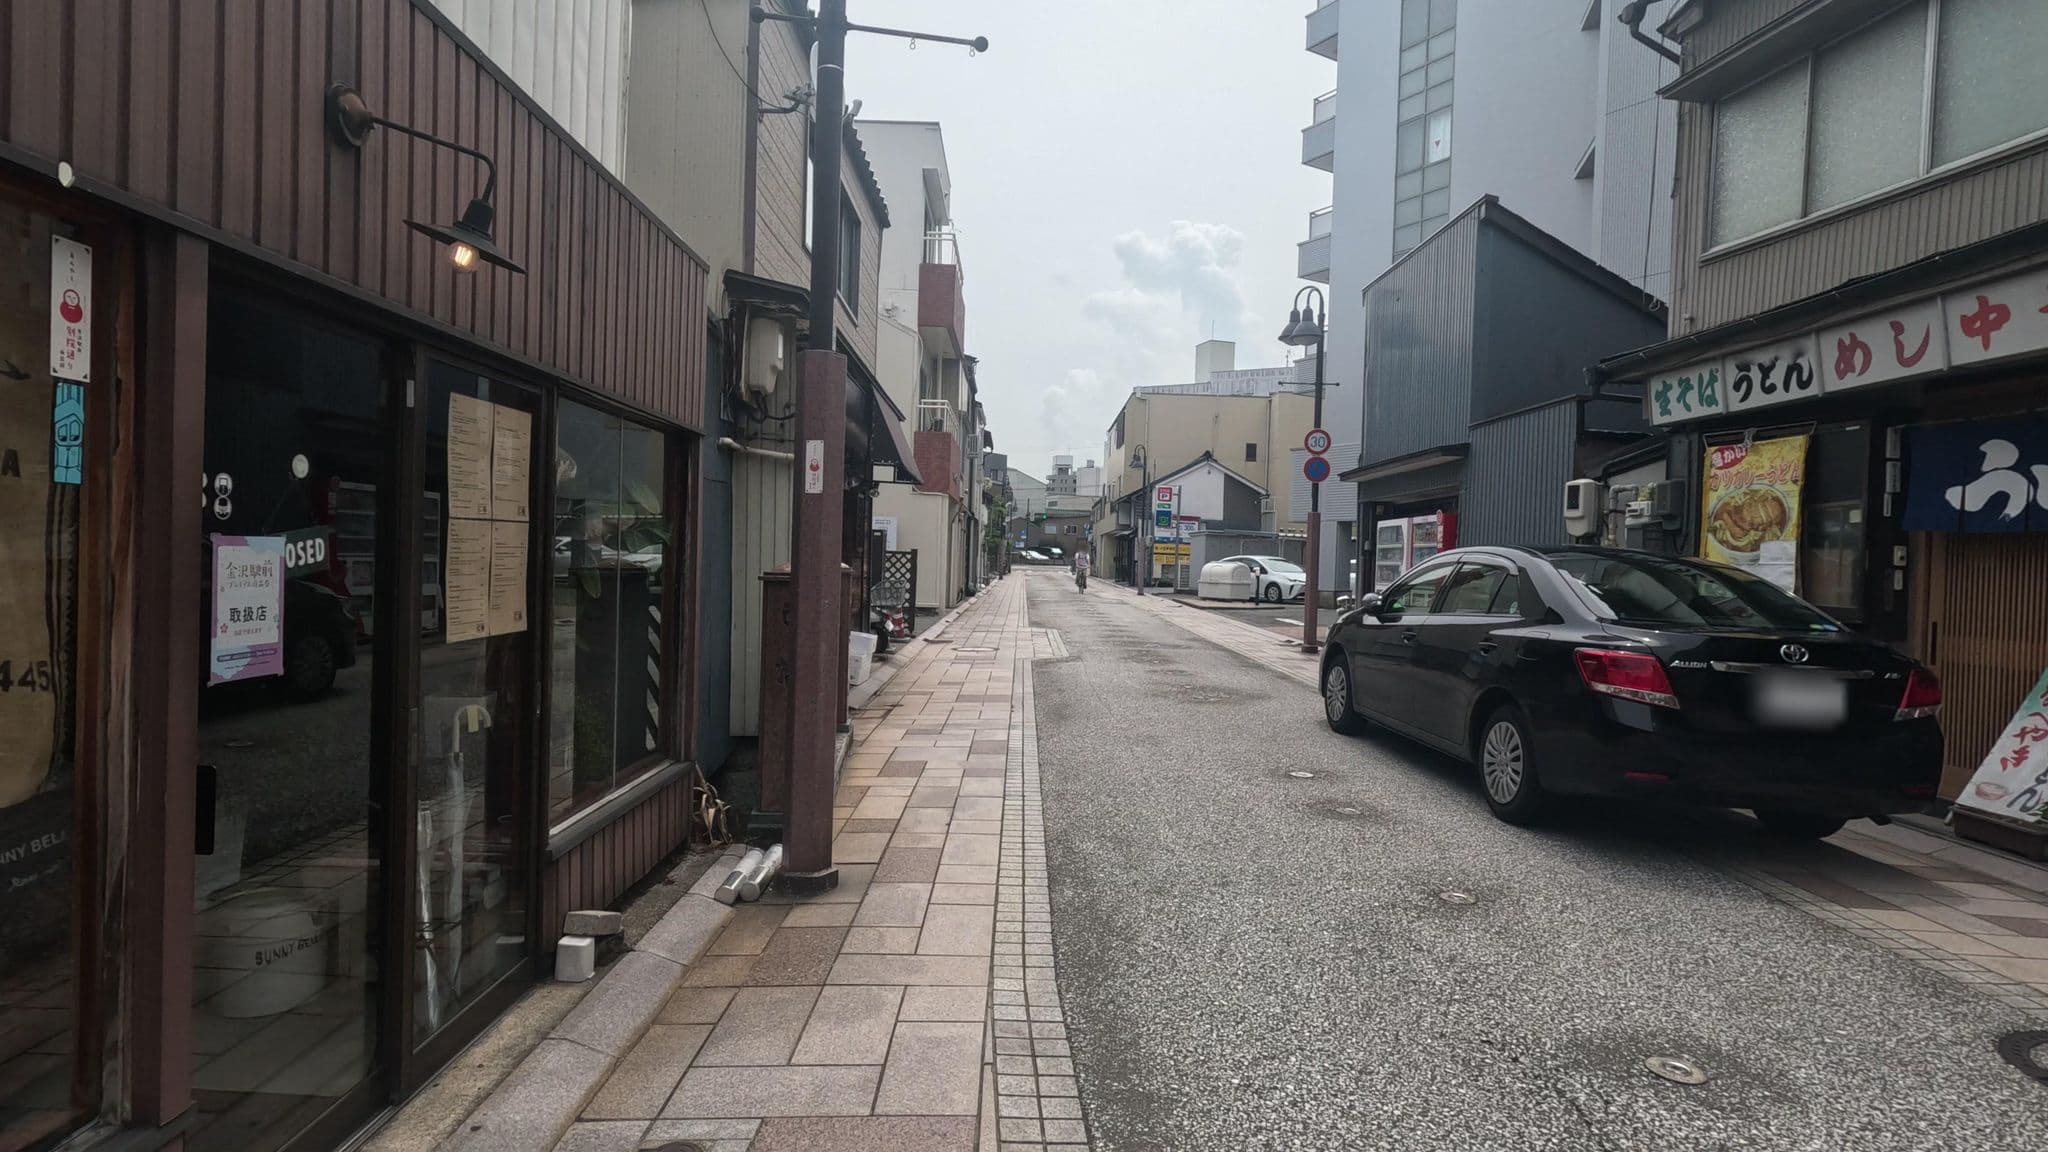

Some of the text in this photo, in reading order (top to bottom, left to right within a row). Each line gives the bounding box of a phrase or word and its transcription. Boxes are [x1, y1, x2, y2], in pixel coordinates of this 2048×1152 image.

[1654, 294, 2048, 417] 生そば うどん めし 中
[1310, 436, 1326, 448] 30
[285, 537, 325, 569] OSED
[229, 605, 268, 623] 取扱店
[1670, 660, 1707, 669] ALLION
[255, 943, 296, 966] SUNNY
